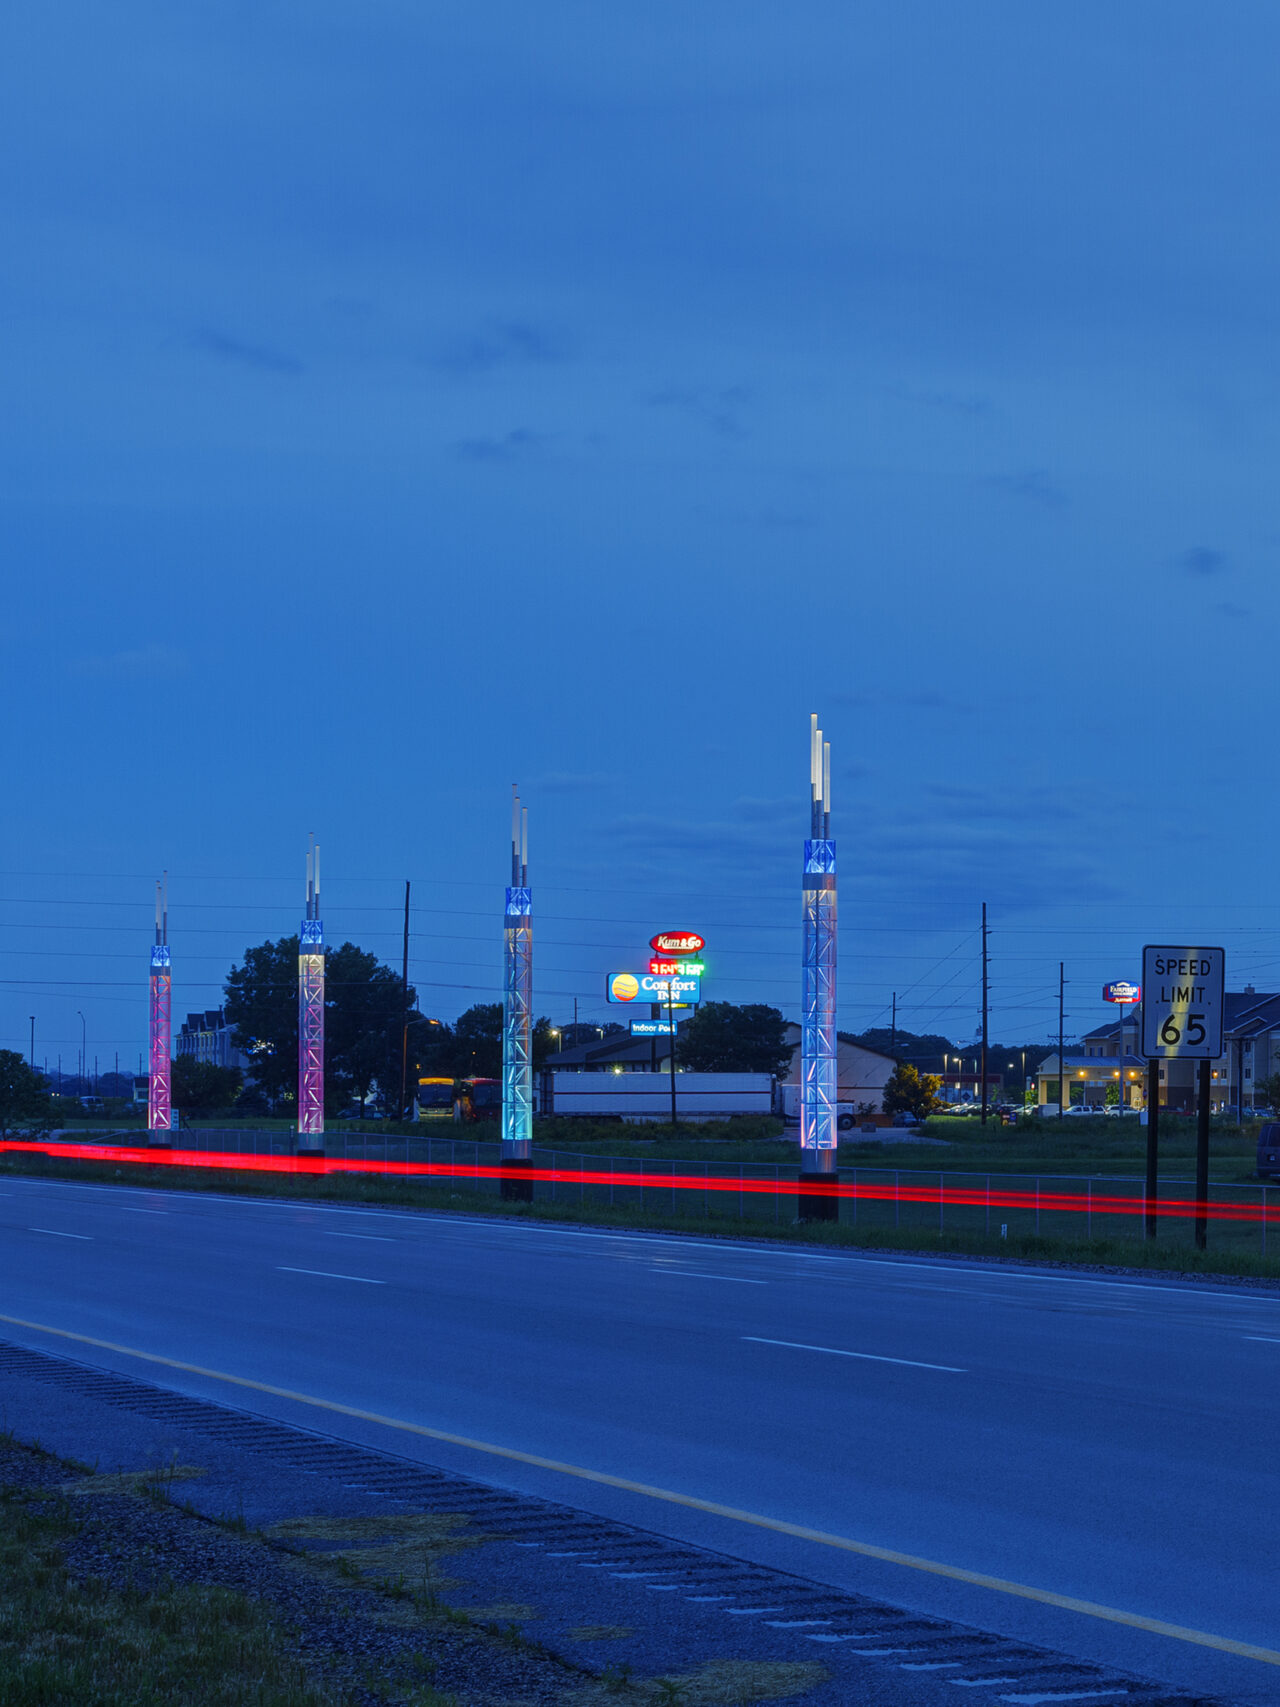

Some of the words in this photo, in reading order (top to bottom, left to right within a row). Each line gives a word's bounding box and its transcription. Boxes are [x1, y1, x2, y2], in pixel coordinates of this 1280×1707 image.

[1155, 959, 1210, 976] SPEED
[641, 977, 696, 991] Comfort
[657, 991, 680, 1000] INN
[1161, 987, 1205, 1003] LIMIT
[633, 1024, 656, 1032] Indoor
[1160, 1014, 1206, 1046] 65
